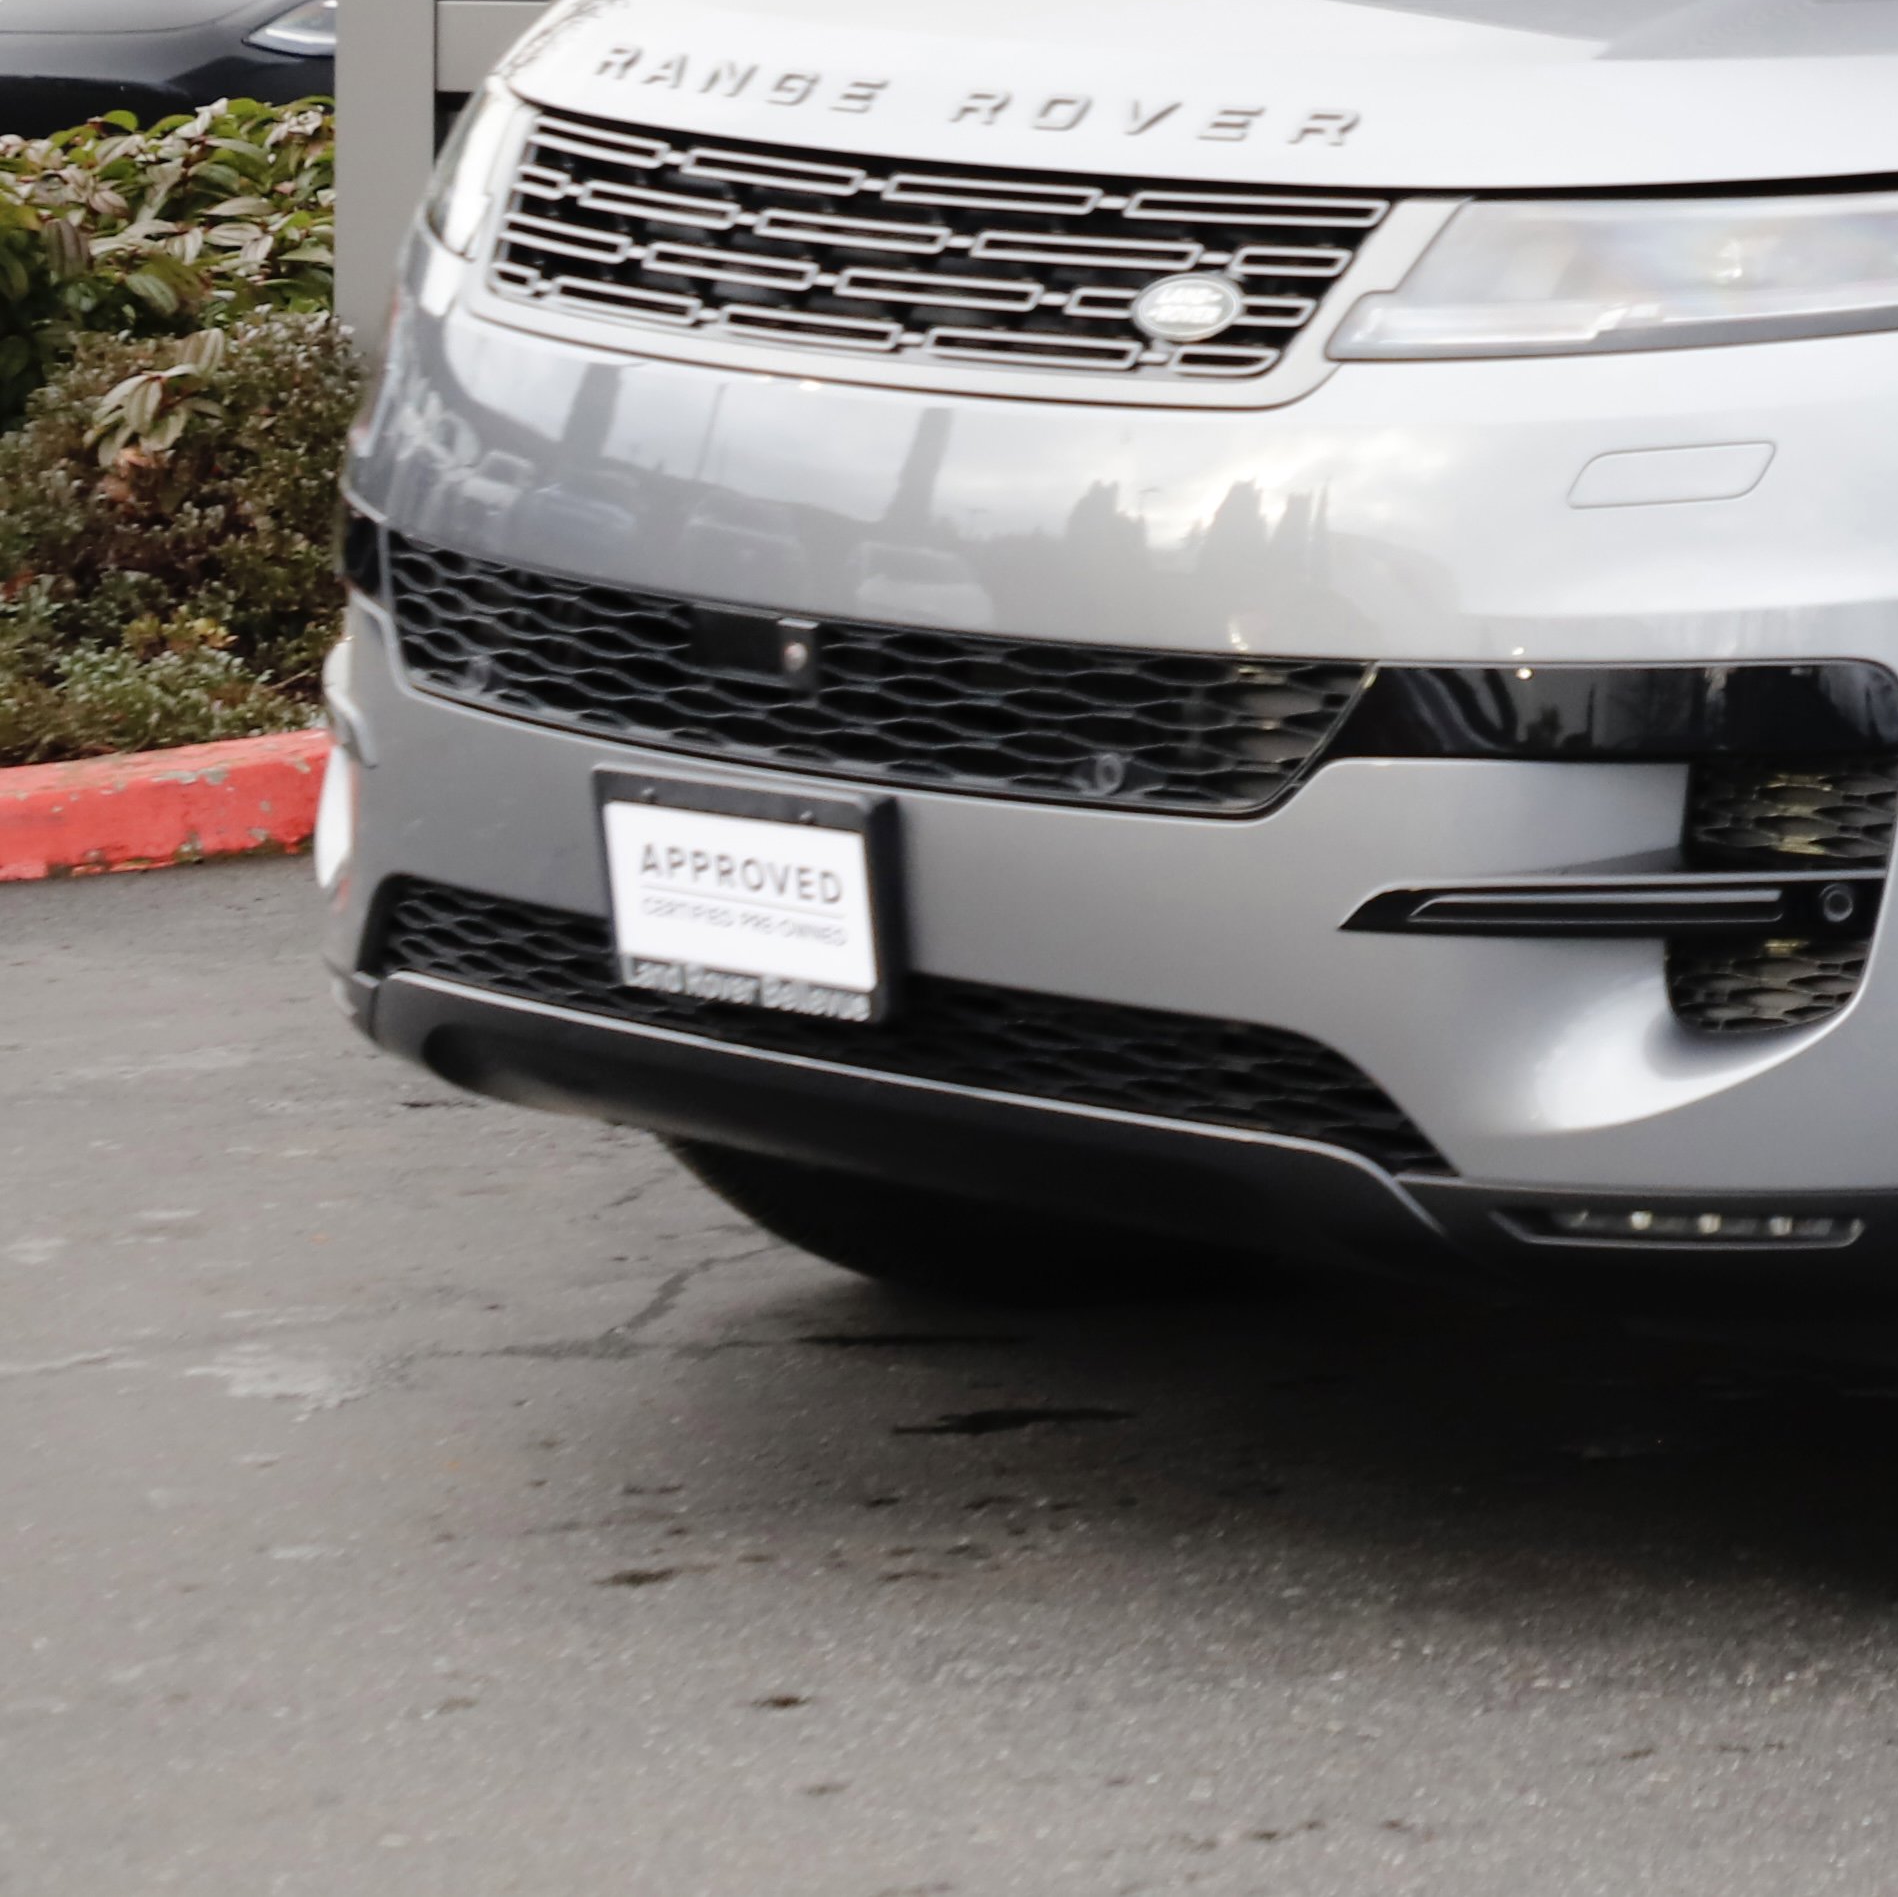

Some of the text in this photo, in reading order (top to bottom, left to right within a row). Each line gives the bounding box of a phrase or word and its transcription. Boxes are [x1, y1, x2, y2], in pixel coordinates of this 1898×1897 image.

[594, 44, 1361, 147] RANGE ROVER
[640, 842, 843, 905] APPROVED
